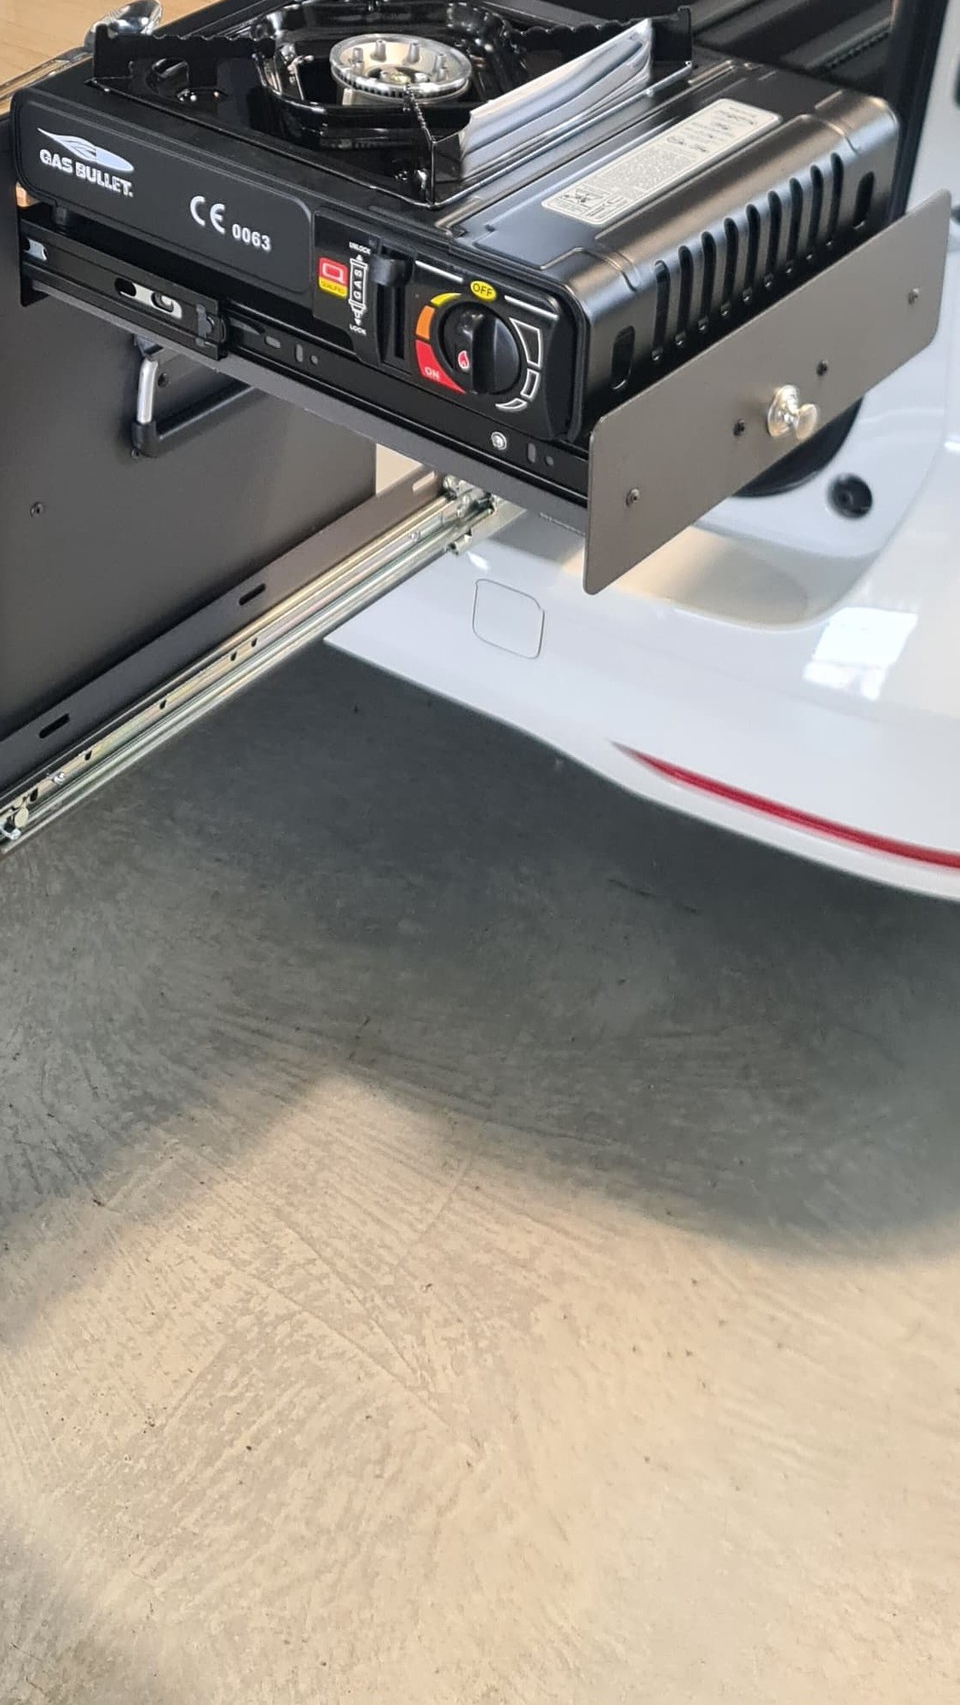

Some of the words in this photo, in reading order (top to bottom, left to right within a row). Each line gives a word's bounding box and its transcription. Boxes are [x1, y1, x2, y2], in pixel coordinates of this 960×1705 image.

[39, 148, 73, 174] GAS
[190, 195, 226, 234] CE
[232, 223, 271, 252] 0063
[353, 268, 363, 300] GAS
[471, 282, 493, 298] OFF
[349, 322, 367, 336] LOCK
[424, 366, 440, 381] ON
